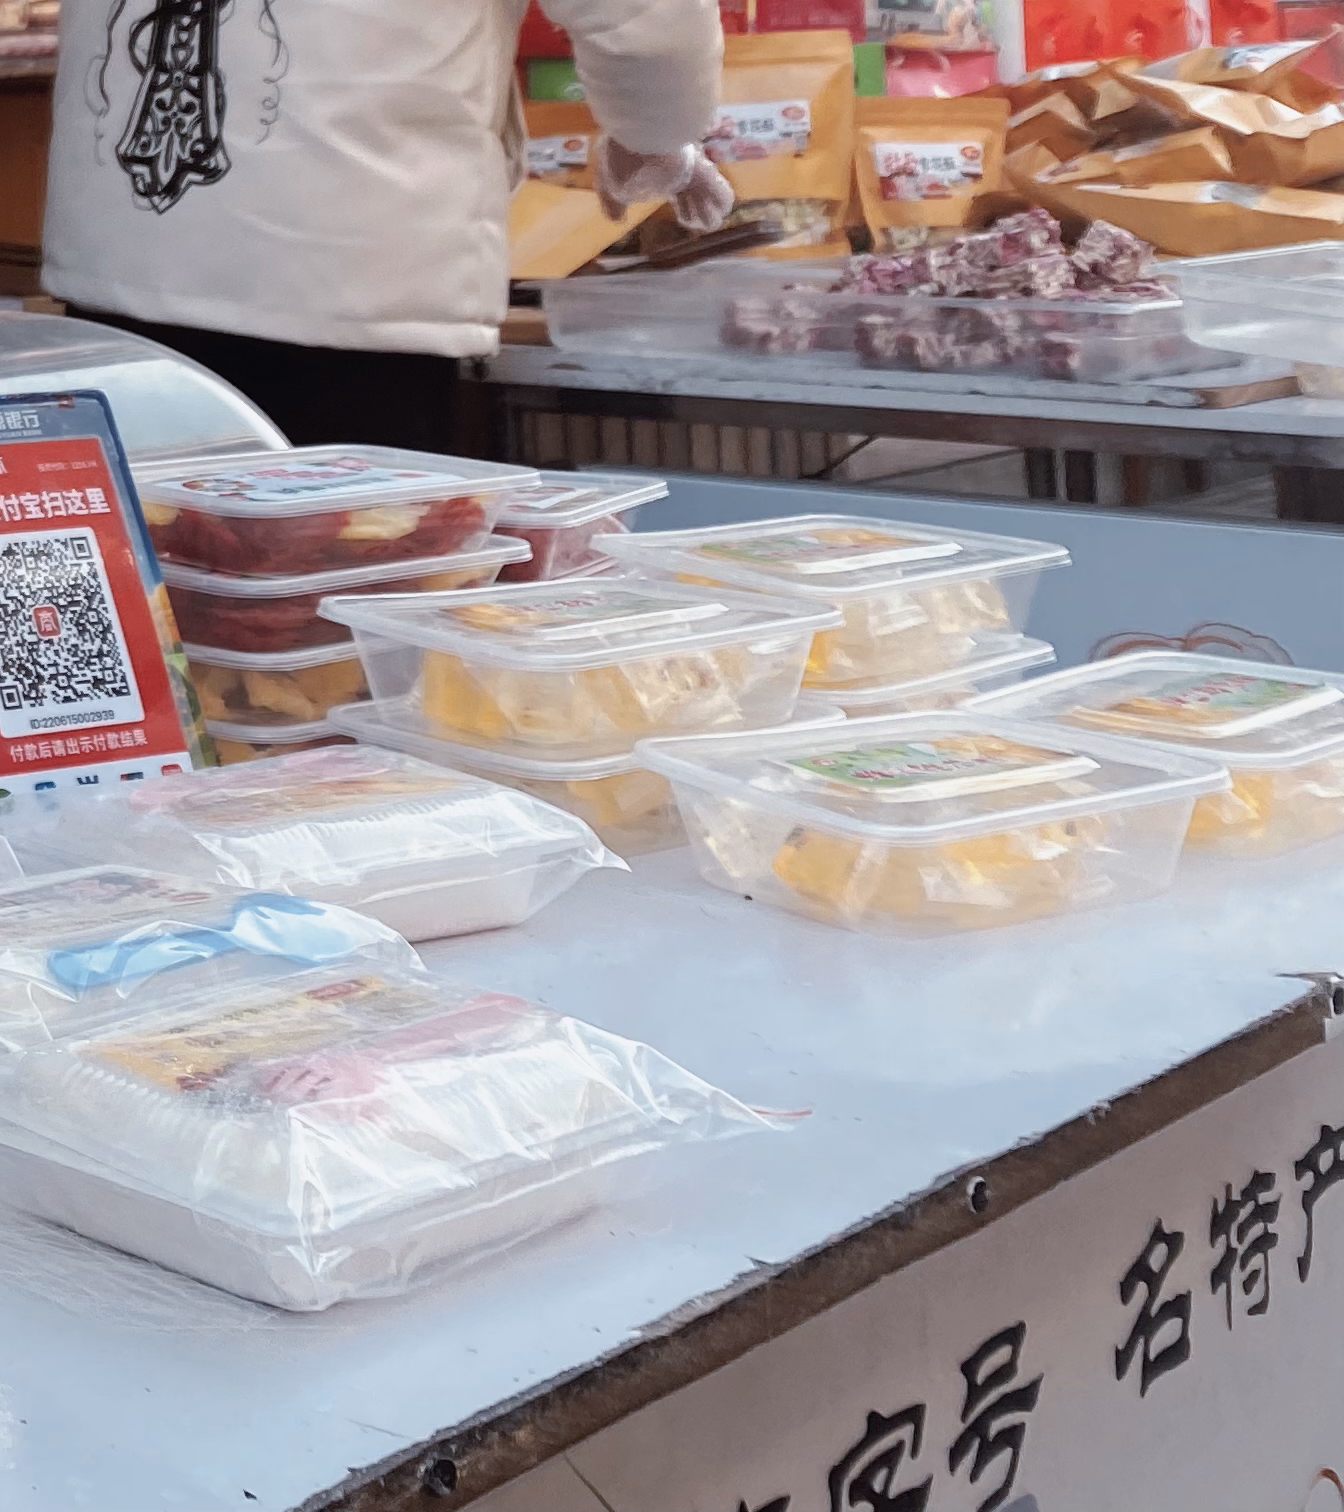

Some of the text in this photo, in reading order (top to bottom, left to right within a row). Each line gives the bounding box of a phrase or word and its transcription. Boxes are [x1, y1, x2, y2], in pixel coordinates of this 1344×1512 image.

[29, 709, 115, 730] ID:220615002939
[9, 729, 149, 763] 付款后请出示付款结果
